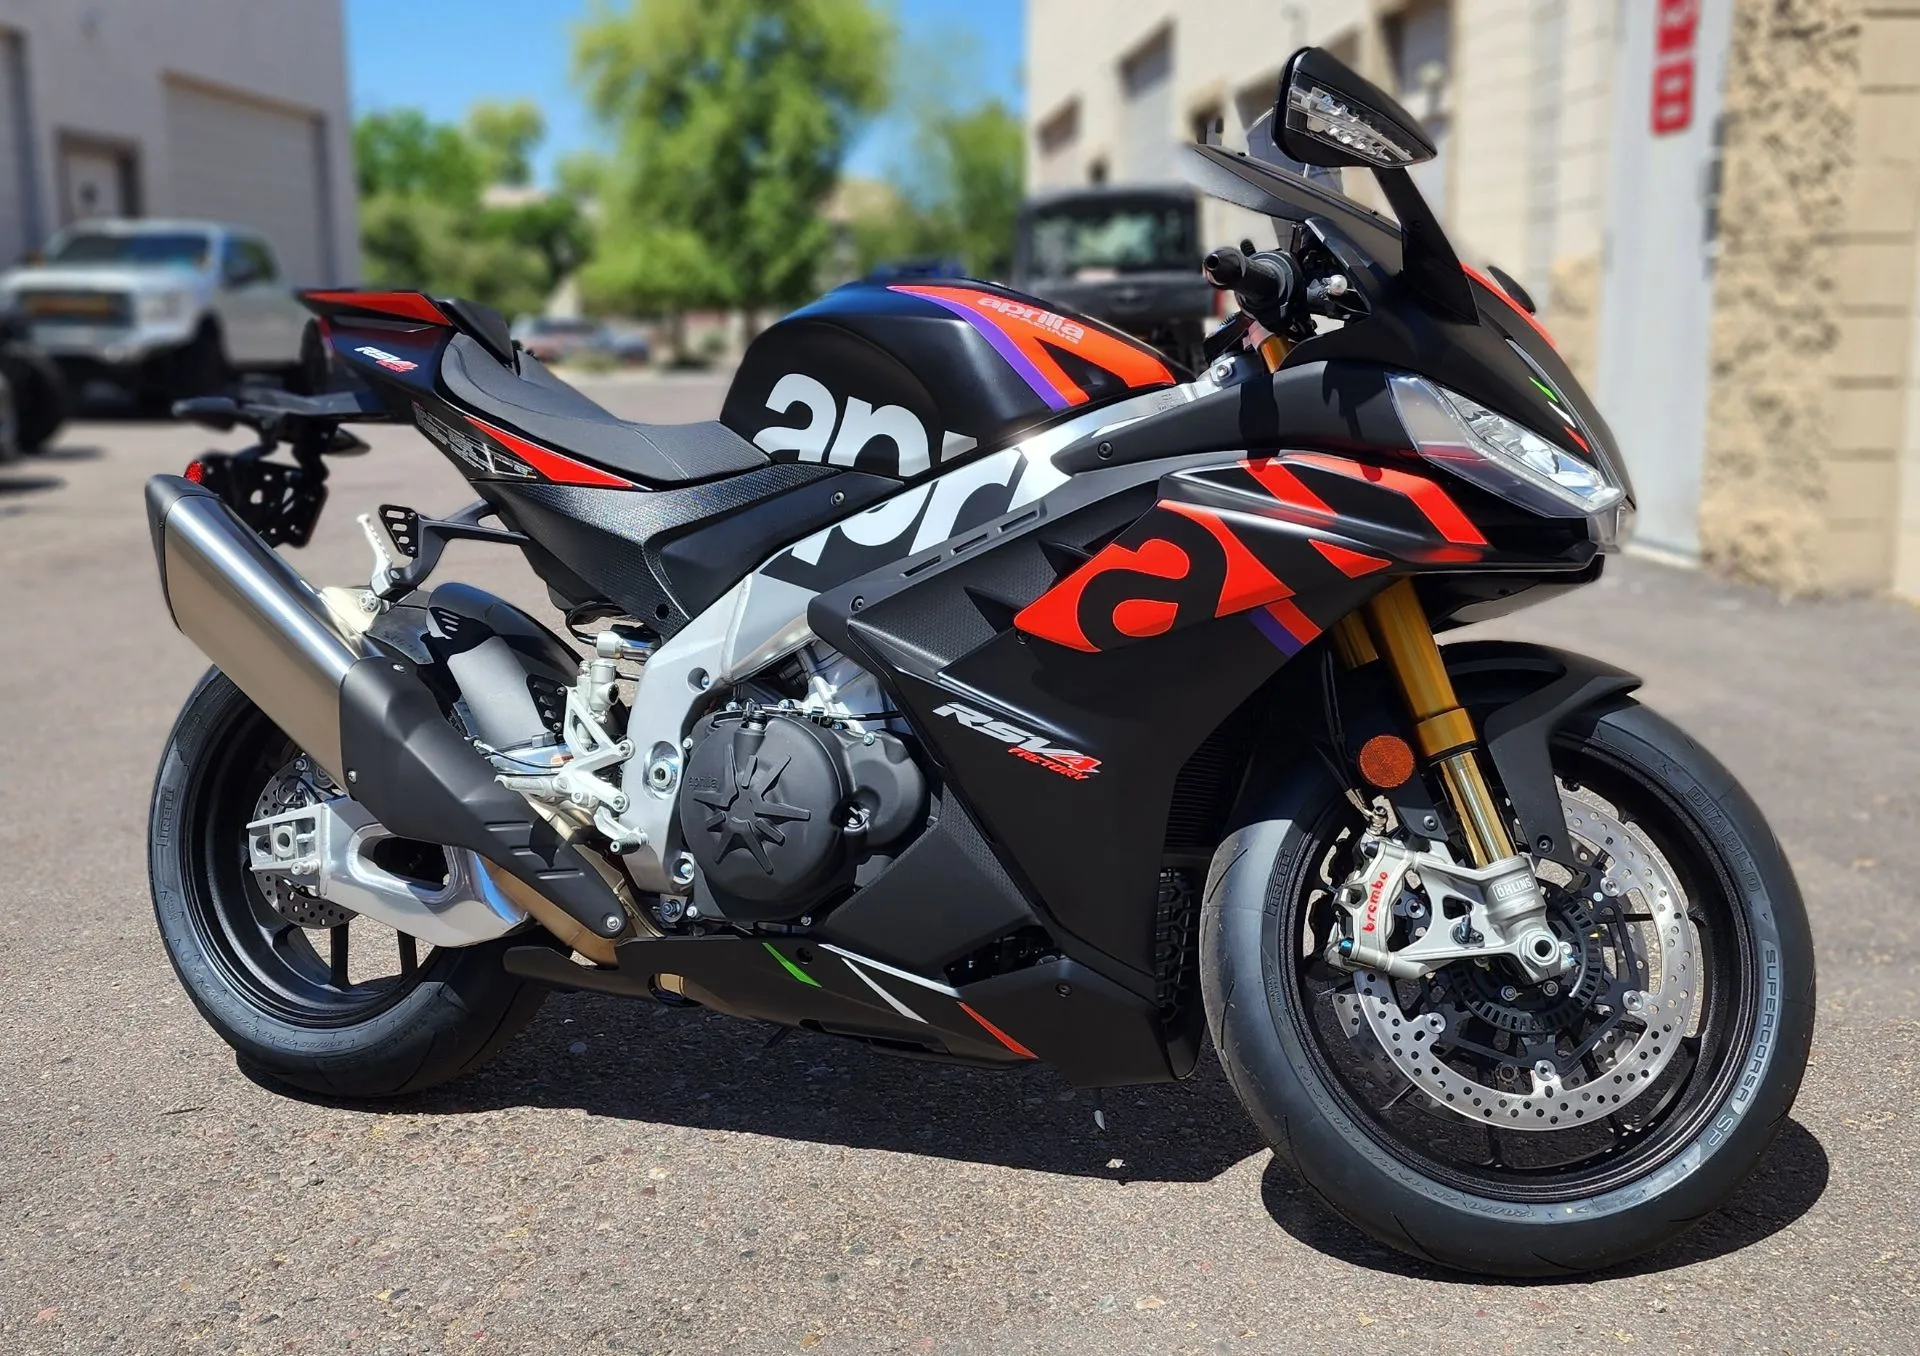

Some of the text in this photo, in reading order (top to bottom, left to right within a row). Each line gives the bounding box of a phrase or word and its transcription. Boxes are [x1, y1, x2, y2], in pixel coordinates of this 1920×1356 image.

[976, 297, 1085, 341] aprilia
[932, 701, 1102, 773] RSV4
[1006, 746, 1090, 781] FACTORY
[1686, 785, 1761, 893] DIABLO
[1362, 870, 1389, 934] brembo
[1496, 876, 1533, 899] ÖHLINS
[1707, 948, 1778, 1147] SUPERCORSA SP
